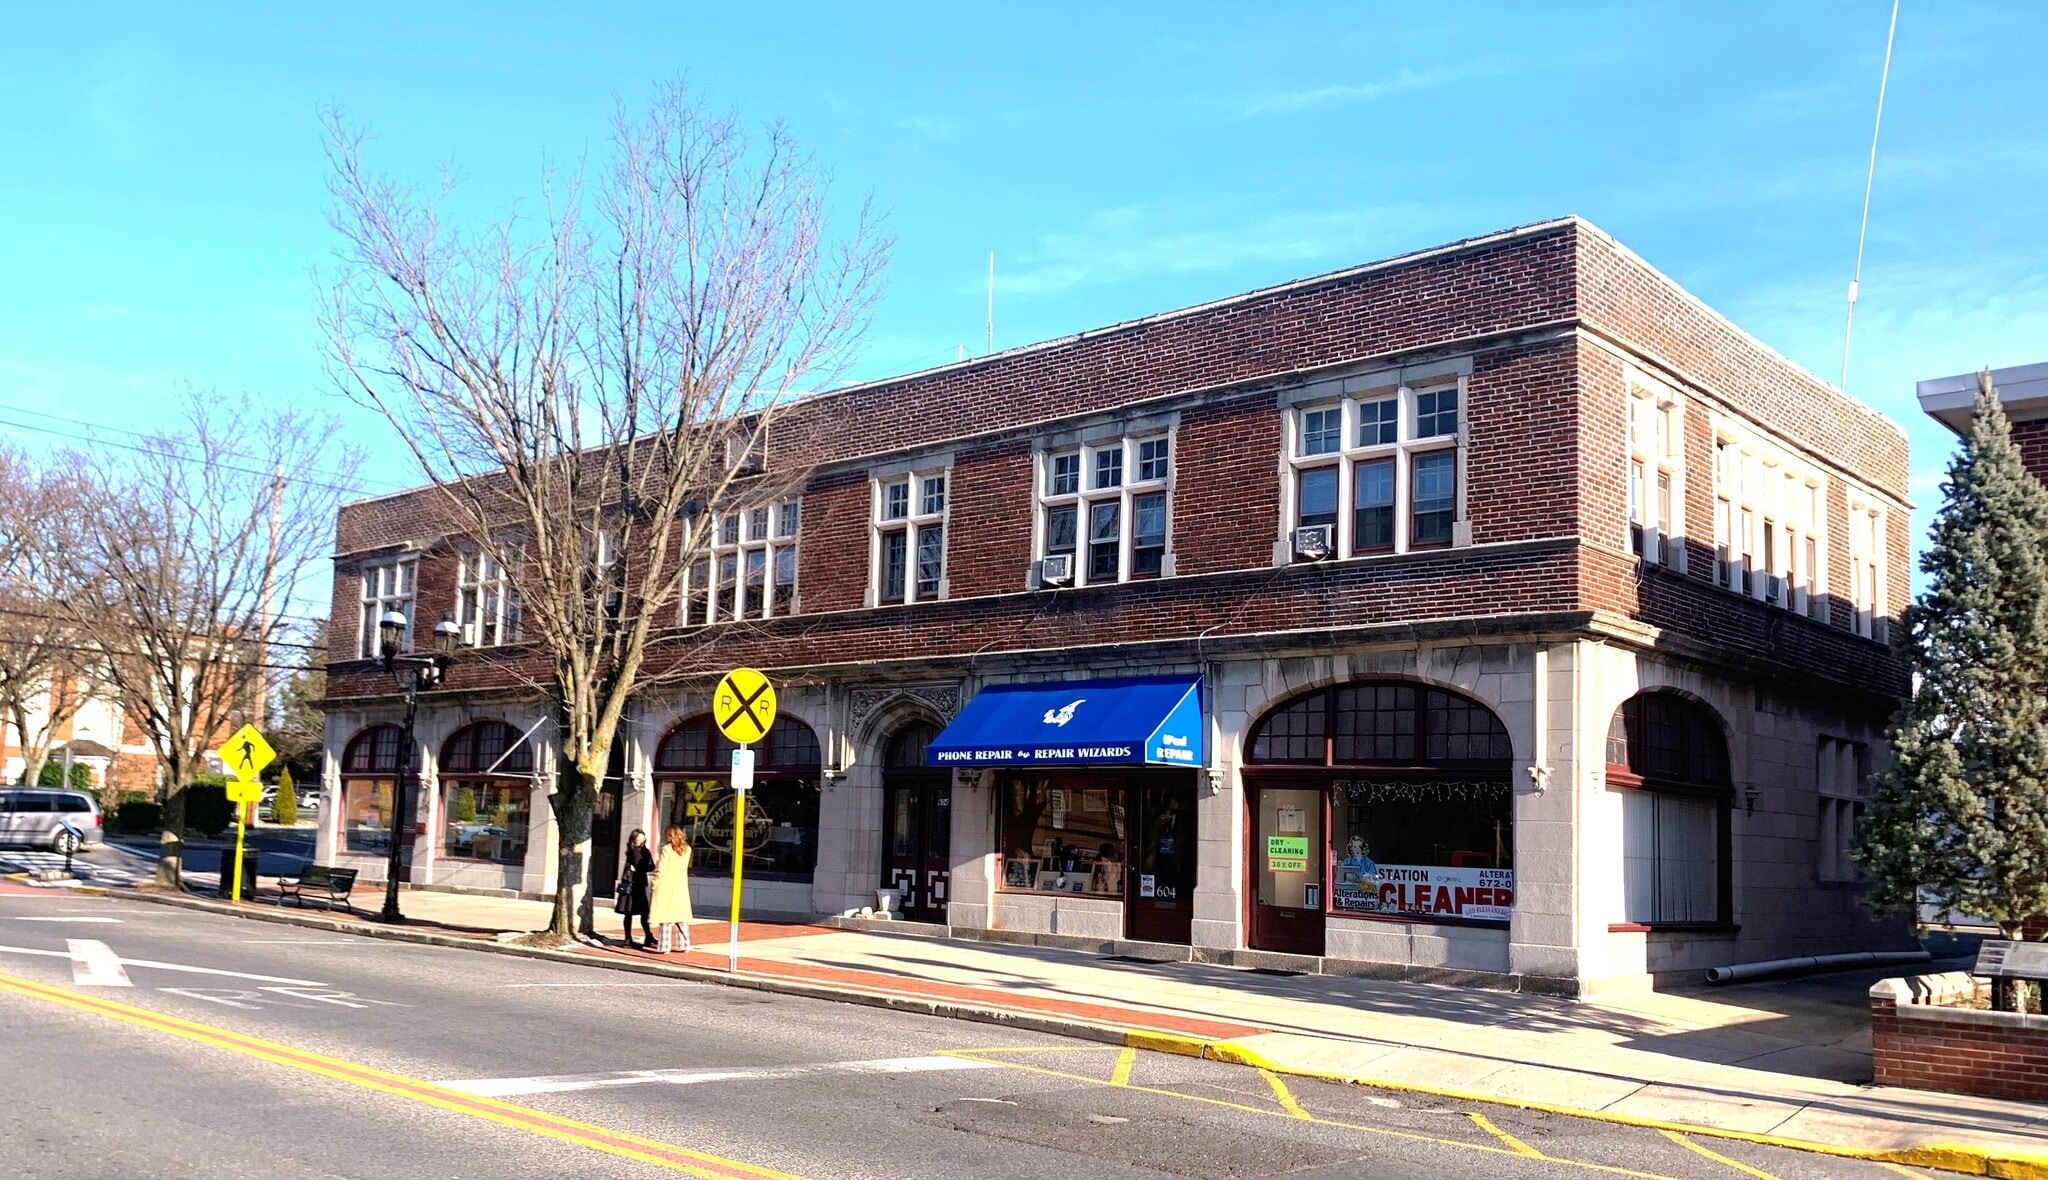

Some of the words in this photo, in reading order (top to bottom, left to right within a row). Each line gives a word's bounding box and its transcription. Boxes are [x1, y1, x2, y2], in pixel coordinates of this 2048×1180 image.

[721, 695, 732, 711] R
[760, 700, 769, 716] R
[938, 751, 972, 760] PHONE
[975, 750, 1012, 760] REPAIR
[1017, 750, 1030, 759] by
[1034, 749, 1074, 759] REPAIR
[1078, 747, 1131, 758] WIZARDS
[1156, 747, 1193, 761] REPAIR
[1270, 847, 1304, 855] CLEANING
[1288, 861, 1302, 869] OFF
[1378, 868, 1429, 882] STATION
[1156, 885, 1176, 899] 604
[1334, 888, 1379, 900] Alterations
[1344, 898, 1376, 909] Repairs
